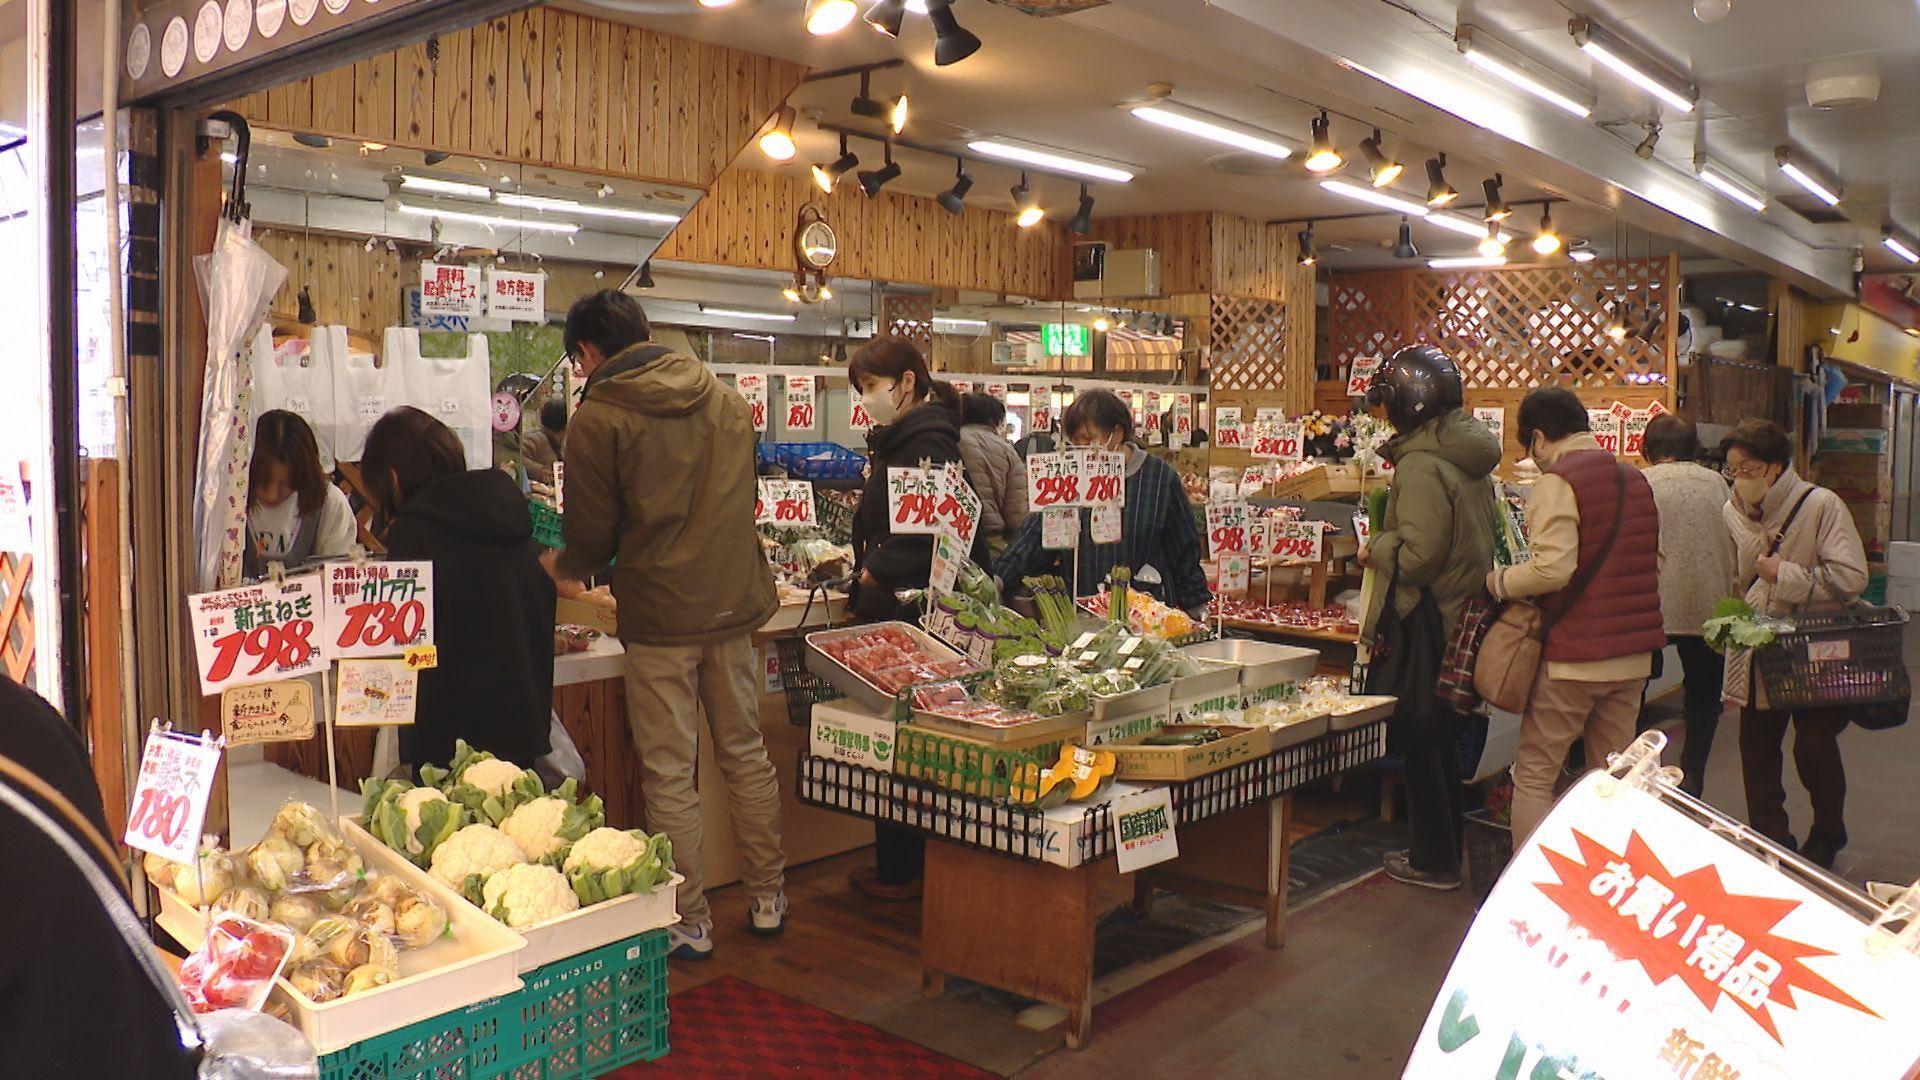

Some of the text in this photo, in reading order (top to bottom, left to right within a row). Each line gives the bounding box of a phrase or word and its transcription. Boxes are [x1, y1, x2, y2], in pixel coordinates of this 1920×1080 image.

[437, 267, 465, 284] 無料
[495, 279, 536, 298] 地方発送
[1034, 474, 1079, 506] 298
[1211, 526, 1245, 554] 98
[332, 566, 389, 581] お買い得品
[235, 594, 312, 631] 新玉ねぎ
[129, 787, 191, 847] 180
[1588, 860, 1784, 1011] お買い得品
